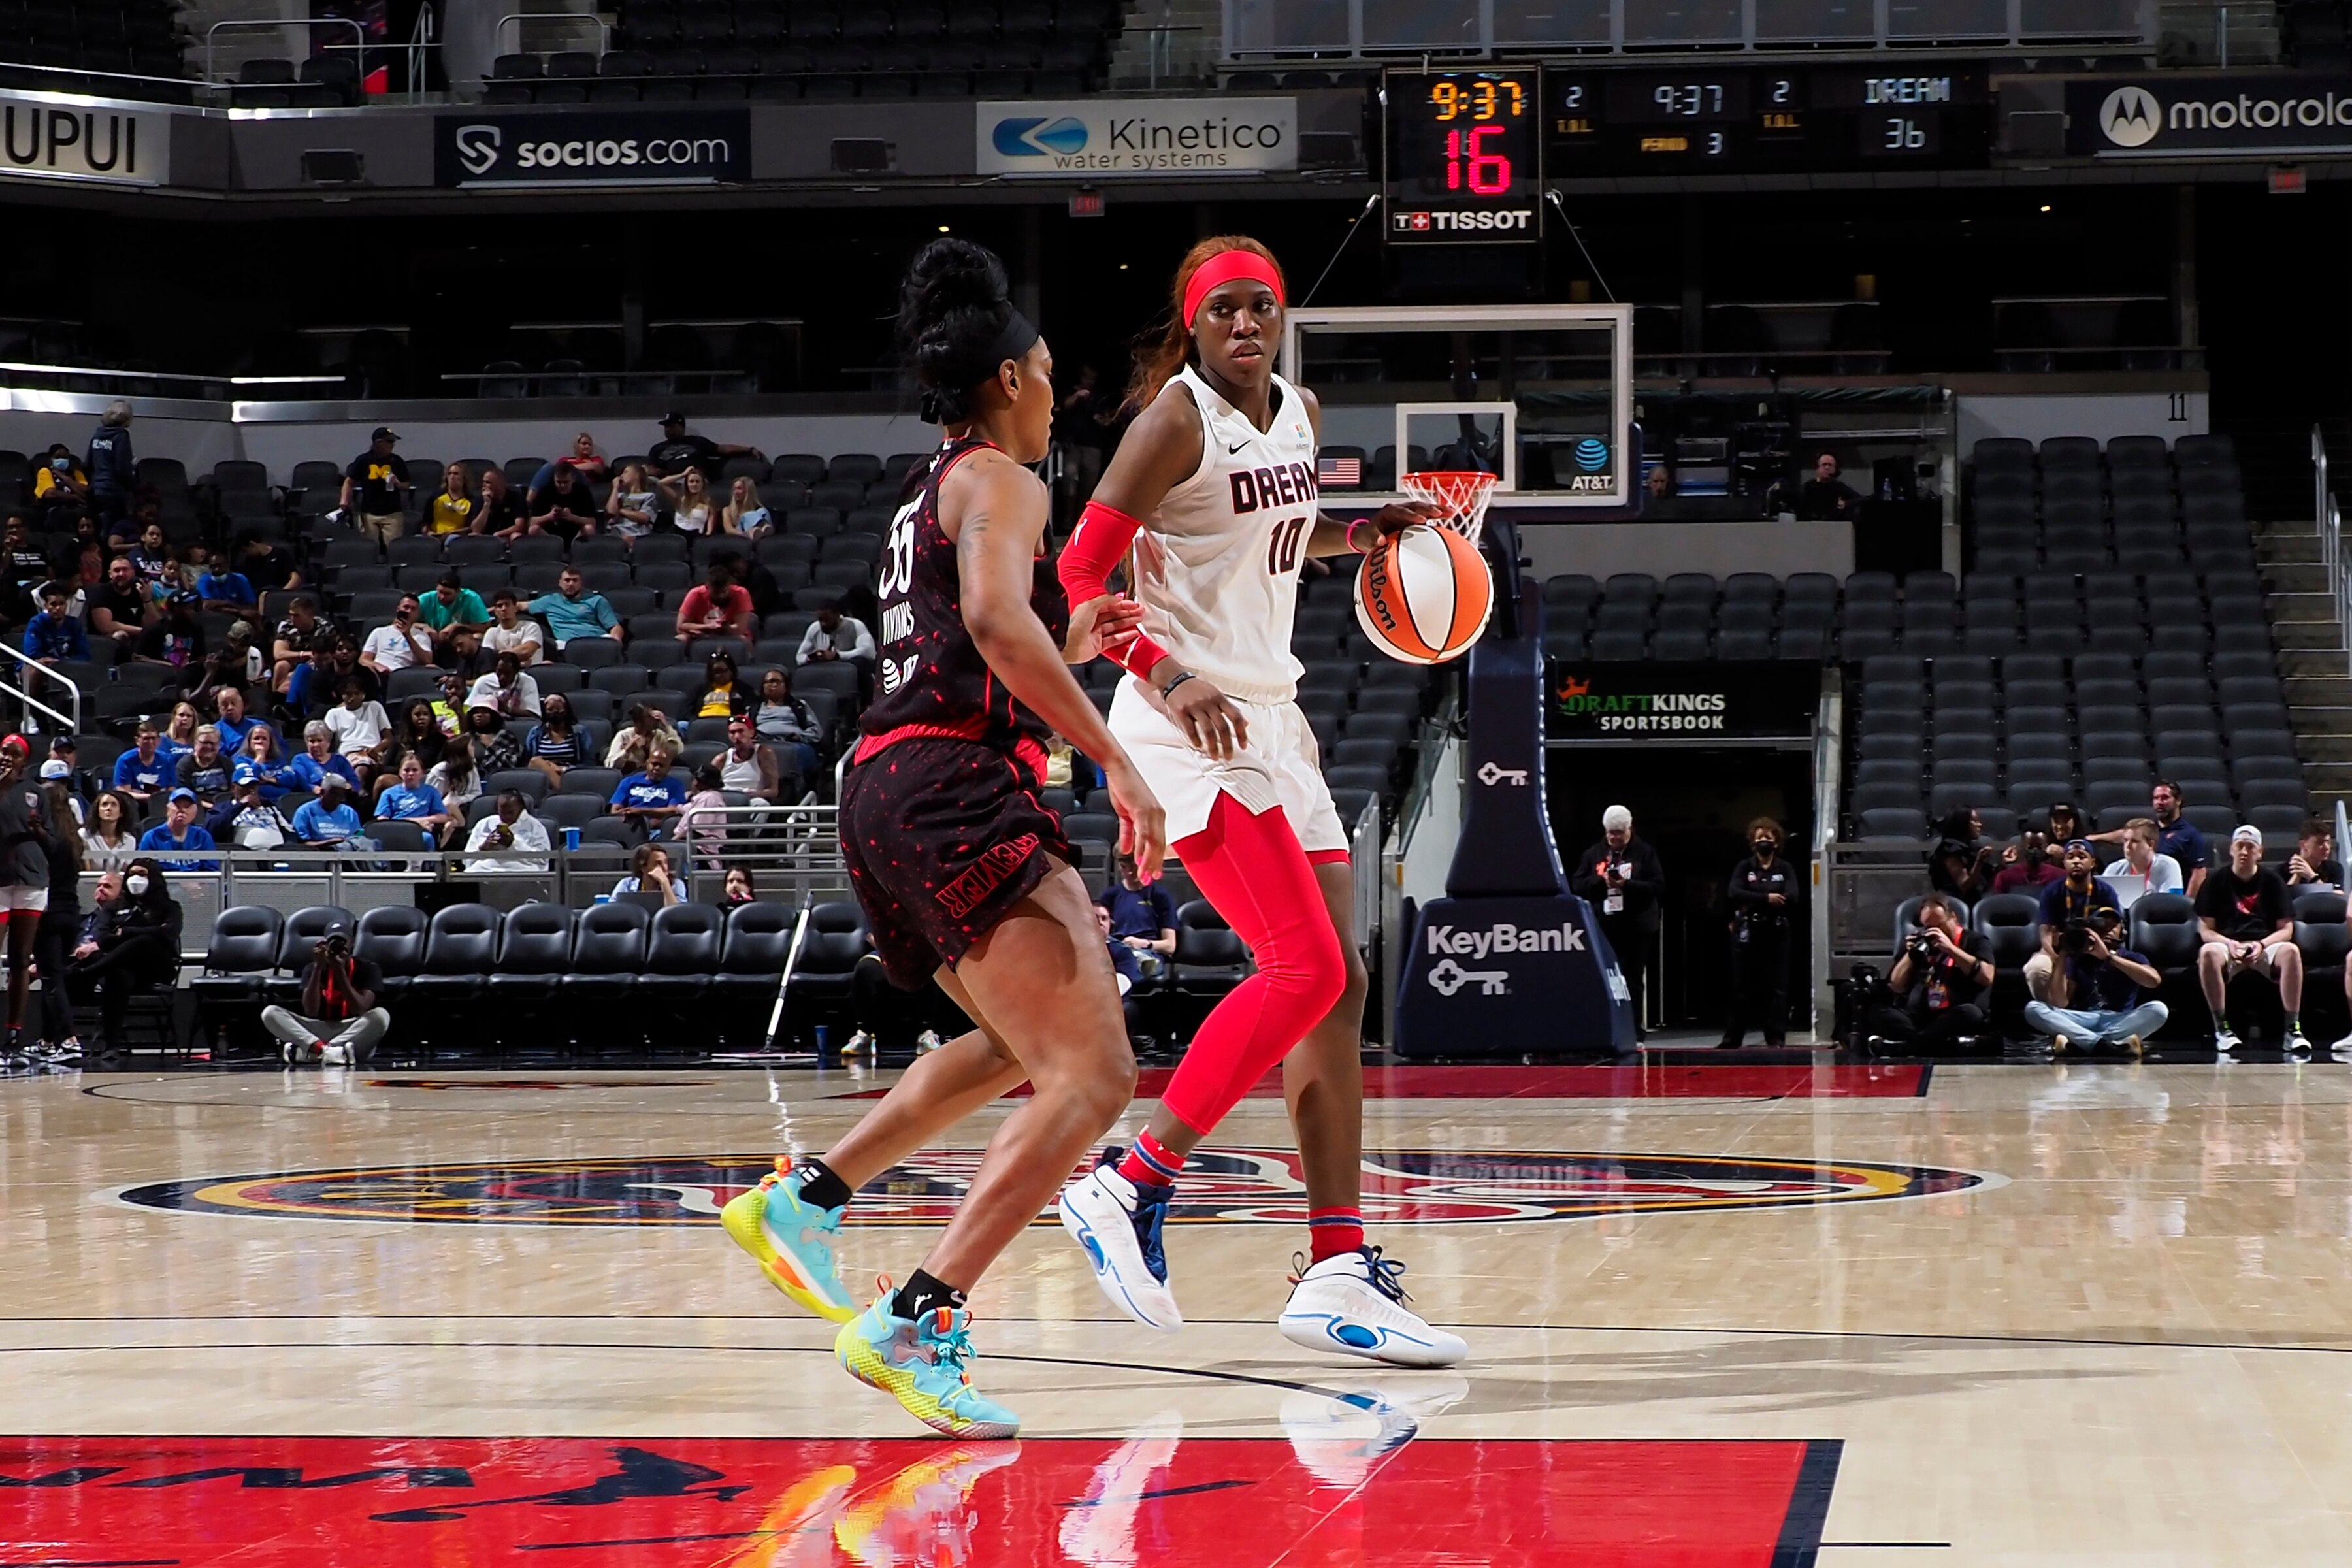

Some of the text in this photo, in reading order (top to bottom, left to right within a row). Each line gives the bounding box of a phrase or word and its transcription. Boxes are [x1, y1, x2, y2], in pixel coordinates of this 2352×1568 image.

[1431, 82, 1522, 120] 9:37
[1565, 86, 1583, 108] 2
[1654, 84, 1724, 115] 9:37
[1772, 80, 1790, 103] 2
[1865, 77, 1950, 104] DREAM
[5, 106, 136, 173] UPUI
[1109, 117, 1281, 150] Kinetico
[1707, 132, 1723, 154] 3
[1884, 118, 1926, 149] 36
[1054, 151, 1227, 171] water systems
[1447, 125, 1511, 194] 16
[1431, 210, 1532, 230] TISSOT
[2168, 392, 2187, 421] 11
[1228, 460, 1318, 515] DREAM
[1571, 476, 1612, 490] AT&T
[1267, 517, 1307, 576] 10
[1369, 542, 1397, 632] Wilson
[1561, 694, 1725, 716] DRAFTKINGS
[1600, 715, 1724, 730] SPORTSBOOK
[1428, 923, 1586, 960] KeyBank
